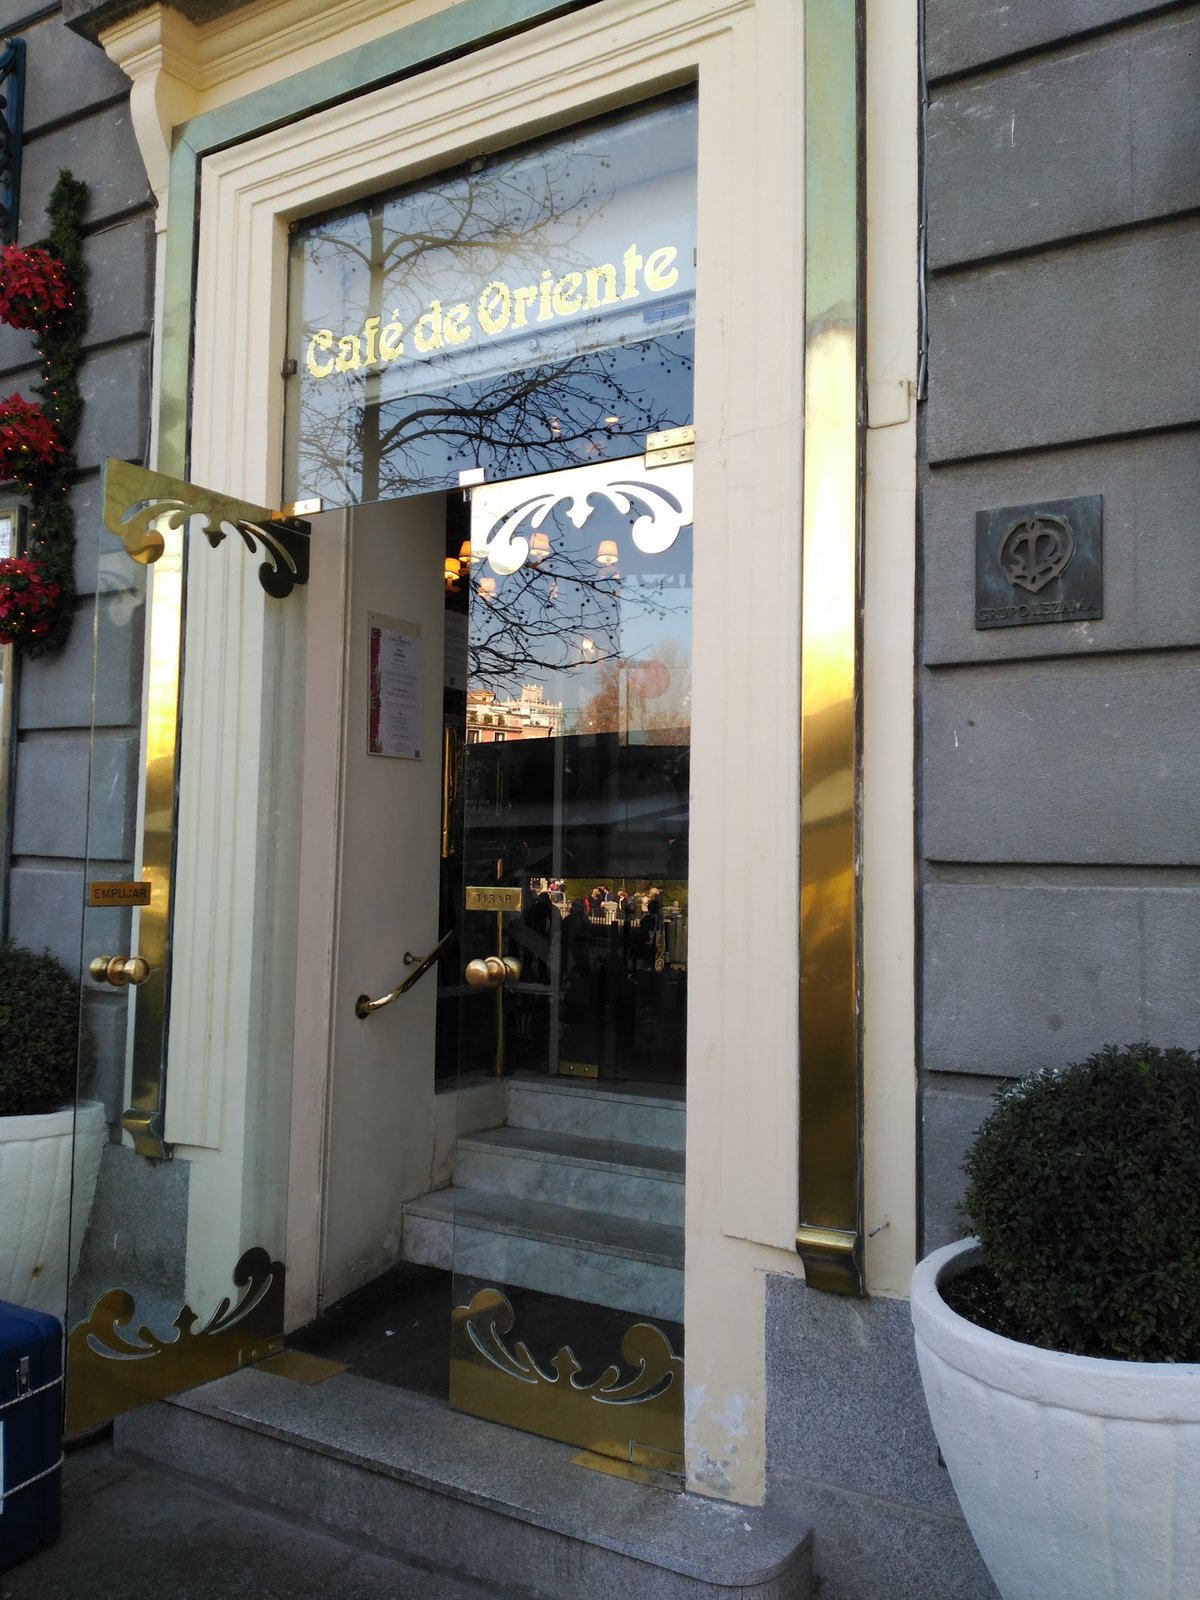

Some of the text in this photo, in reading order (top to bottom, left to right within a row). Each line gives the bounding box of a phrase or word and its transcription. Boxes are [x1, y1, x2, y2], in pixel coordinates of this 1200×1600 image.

[306, 243, 680, 379] Café de Oriente
[978, 604, 1030, 621] GRUPO
[94, 888, 147, 899] EMPUJAR
[476, 893, 512, 904] TIRAR
